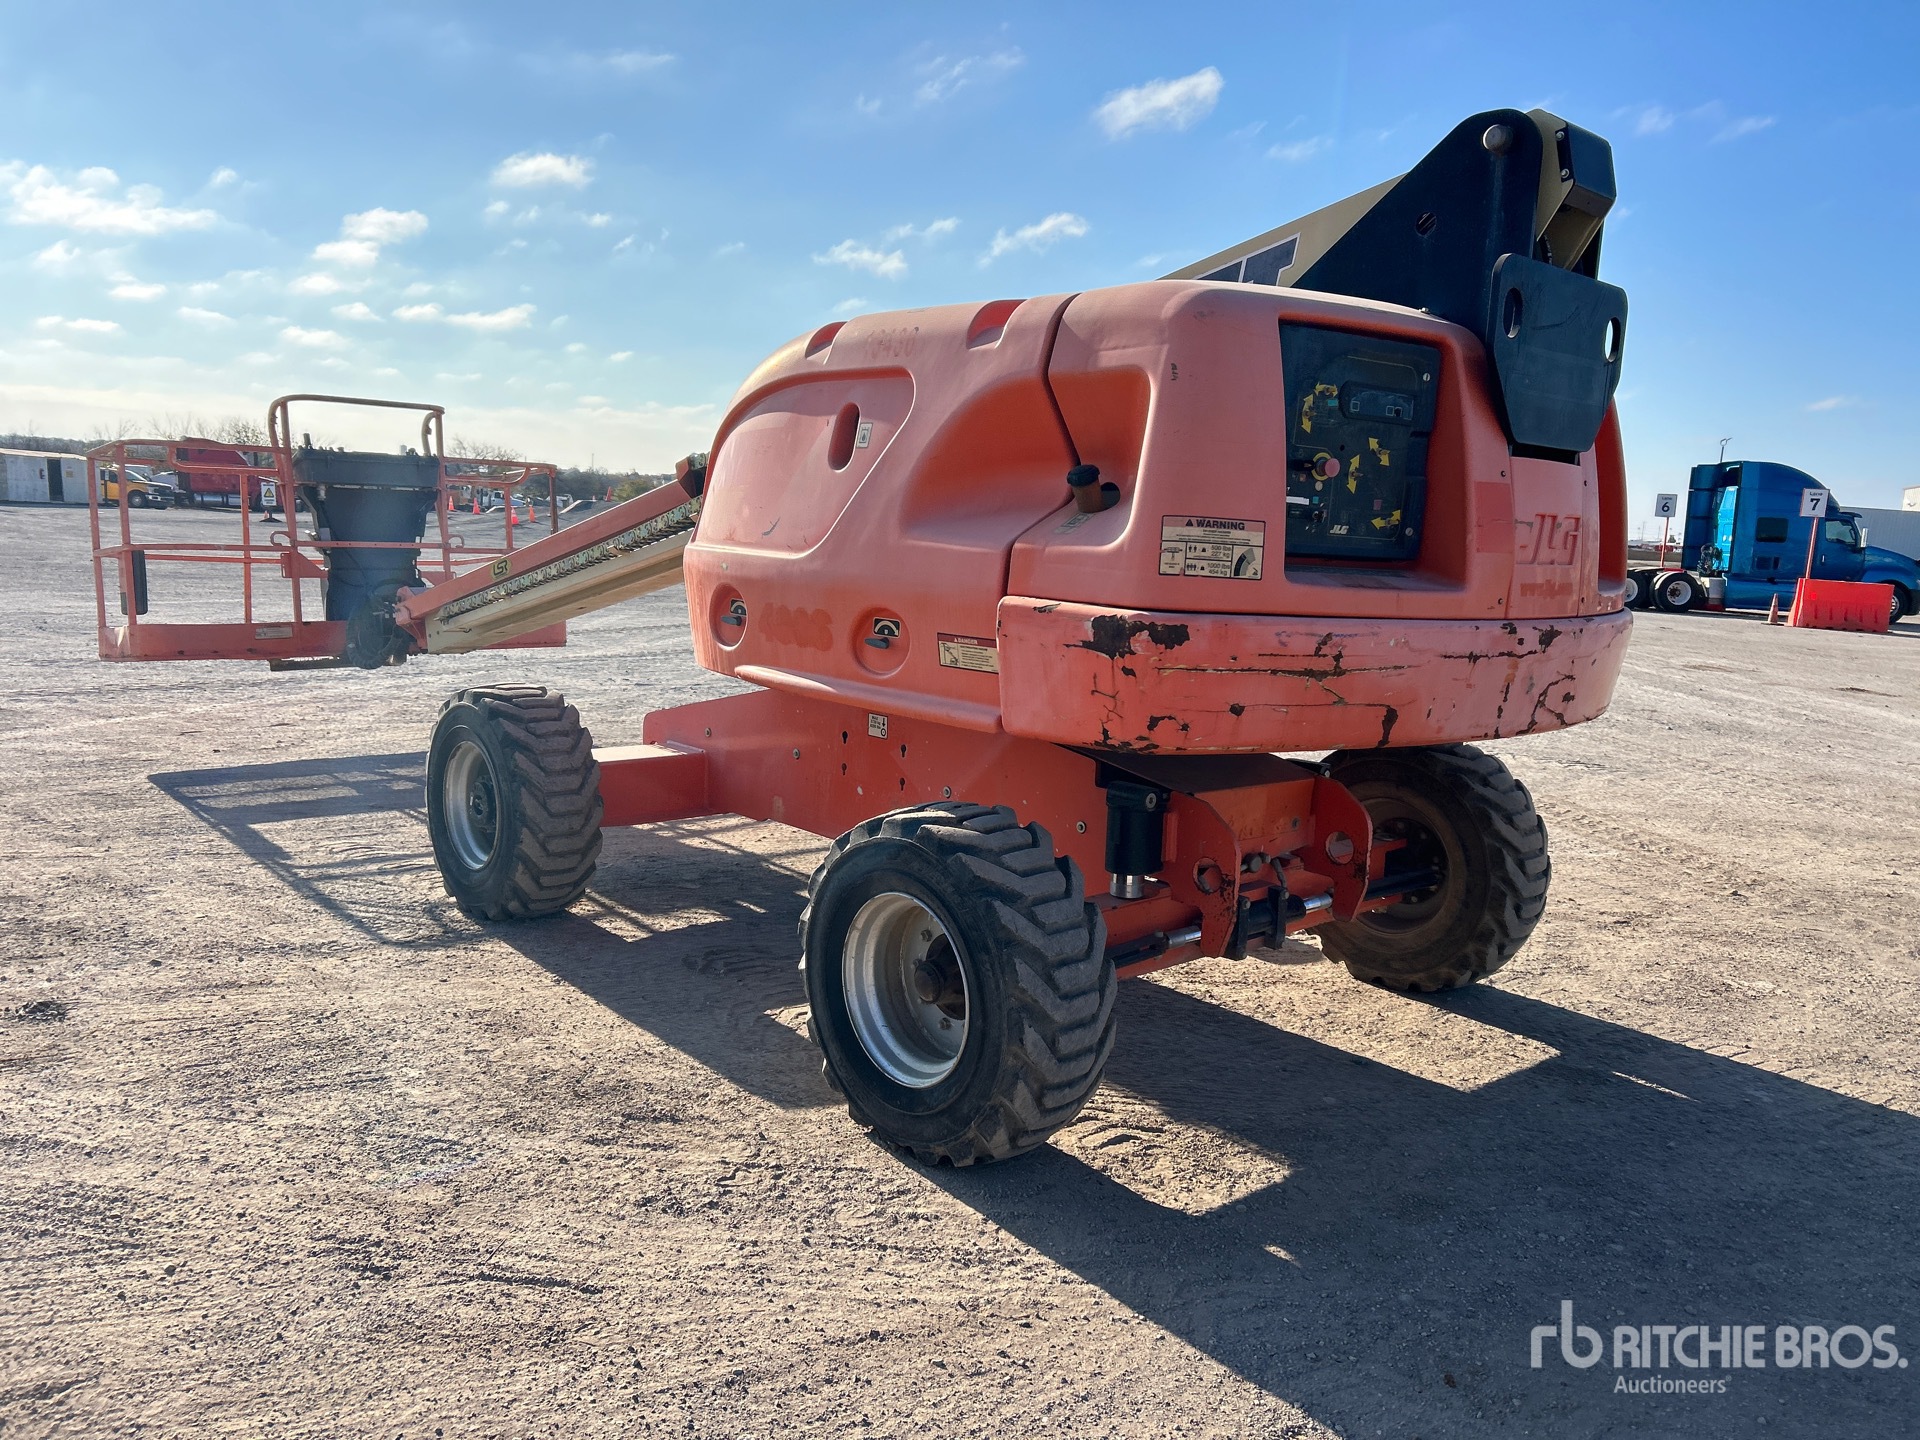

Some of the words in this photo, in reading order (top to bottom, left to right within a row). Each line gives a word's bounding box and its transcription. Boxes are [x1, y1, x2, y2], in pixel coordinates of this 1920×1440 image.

[1661, 501, 1670, 513] 6
[1810, 498, 1821, 511] 7
[1196, 519, 1245, 530] WARNING
[1329, 524, 1349, 535] JLG
[1516, 513, 1581, 566] JLG
